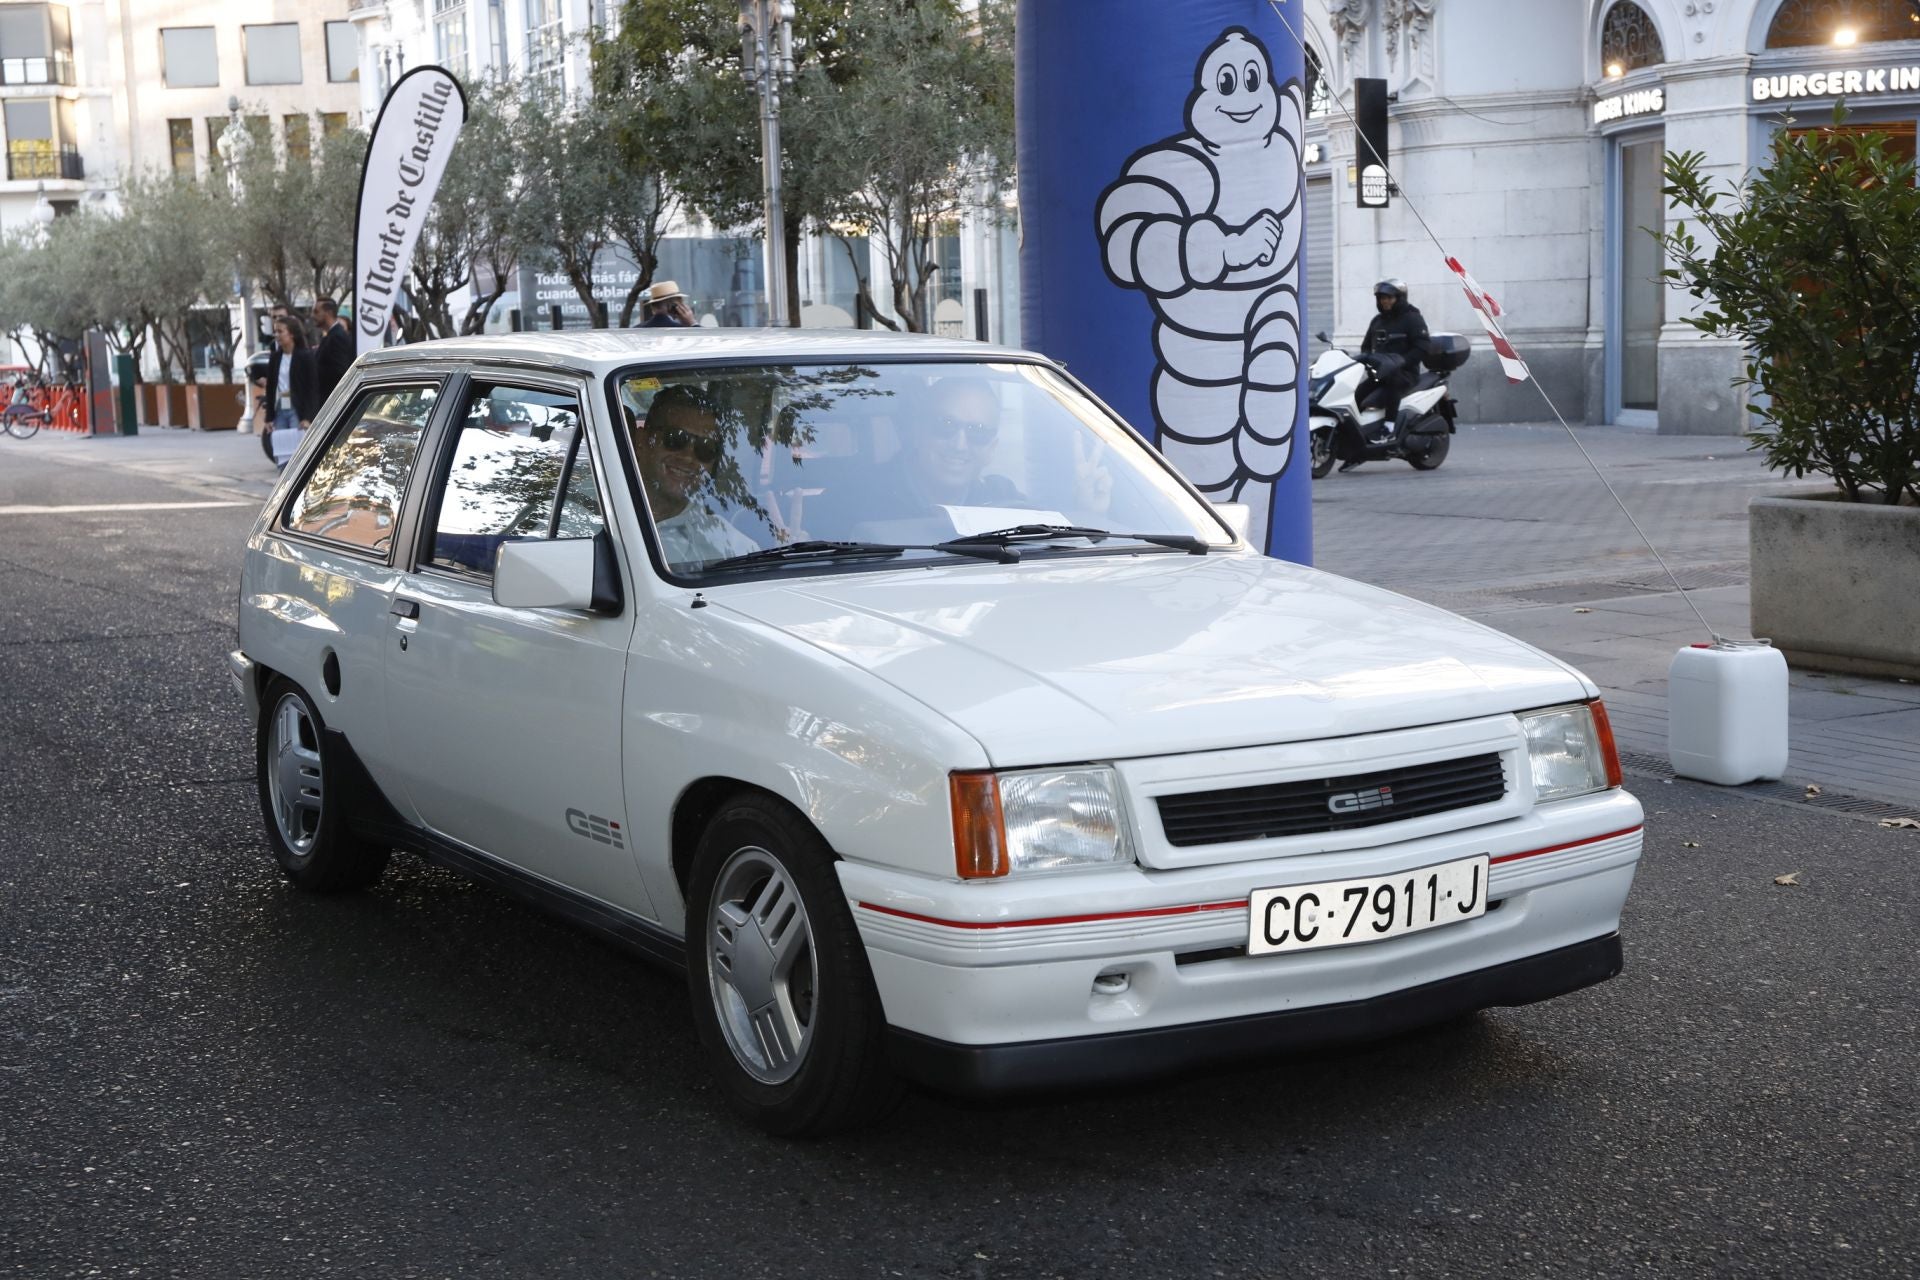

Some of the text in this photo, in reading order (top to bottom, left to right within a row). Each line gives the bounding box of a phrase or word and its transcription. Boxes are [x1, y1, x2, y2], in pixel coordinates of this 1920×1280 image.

[1752, 67, 1920, 101] BURGER KIN
[1623, 88, 1664, 116] KING
[1362, 185, 1387, 197] KING
[360, 80, 453, 337] El Norte de Castilla
